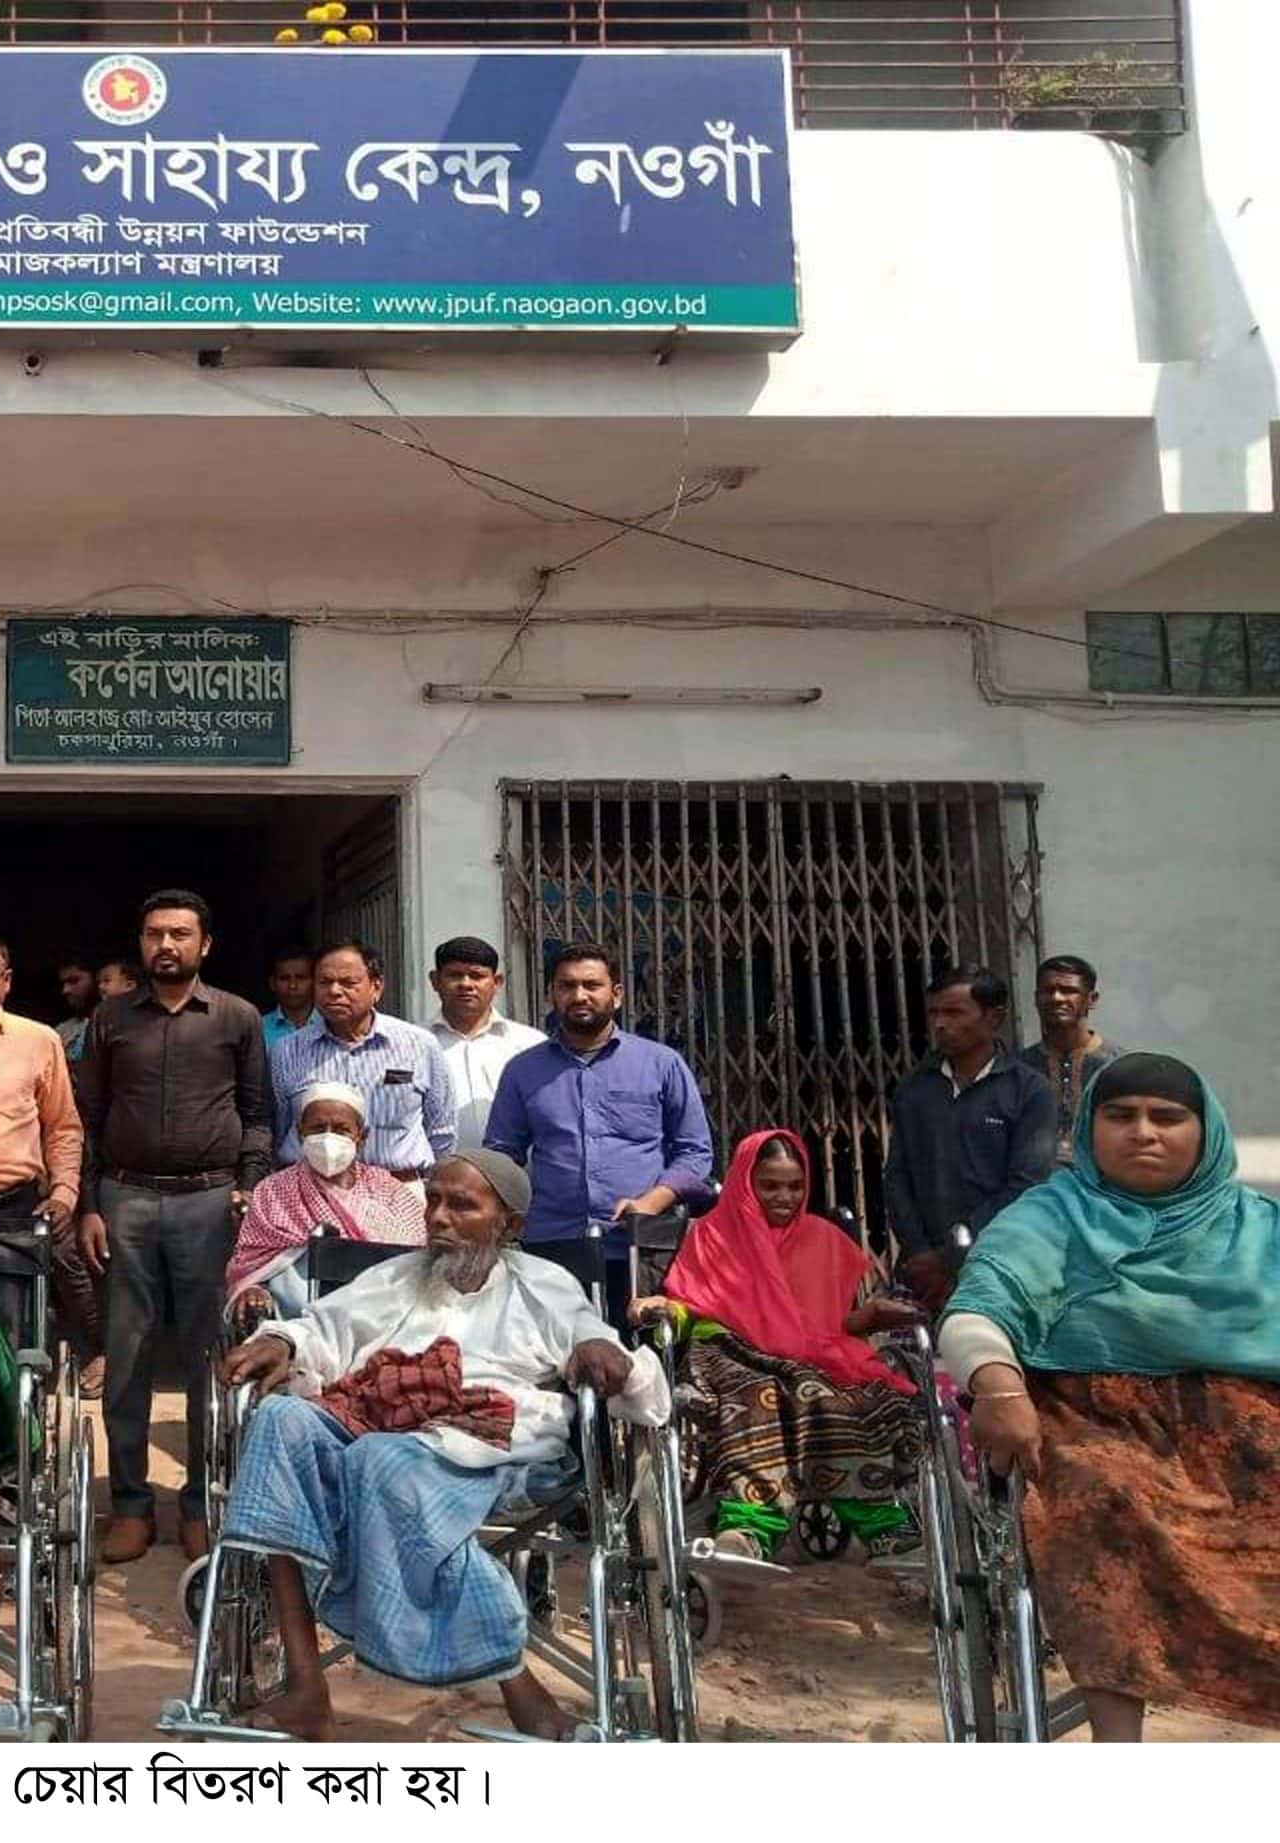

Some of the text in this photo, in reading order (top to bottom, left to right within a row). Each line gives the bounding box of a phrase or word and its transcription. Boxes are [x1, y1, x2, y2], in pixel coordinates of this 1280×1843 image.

[73, 131, 320, 211] সাহায্য
[345, 141, 542, 218] কেন্দ্র,
[564, 120, 773, 207] নওগাঁ
[115, 214, 209, 247] উন্নয়ন
[215, 215, 371, 245] ফাউন্ডেশন
[252, 292, 361, 313] Website:
[373, 294, 706, 319] www.jpuf.naogaon.gov.bd
